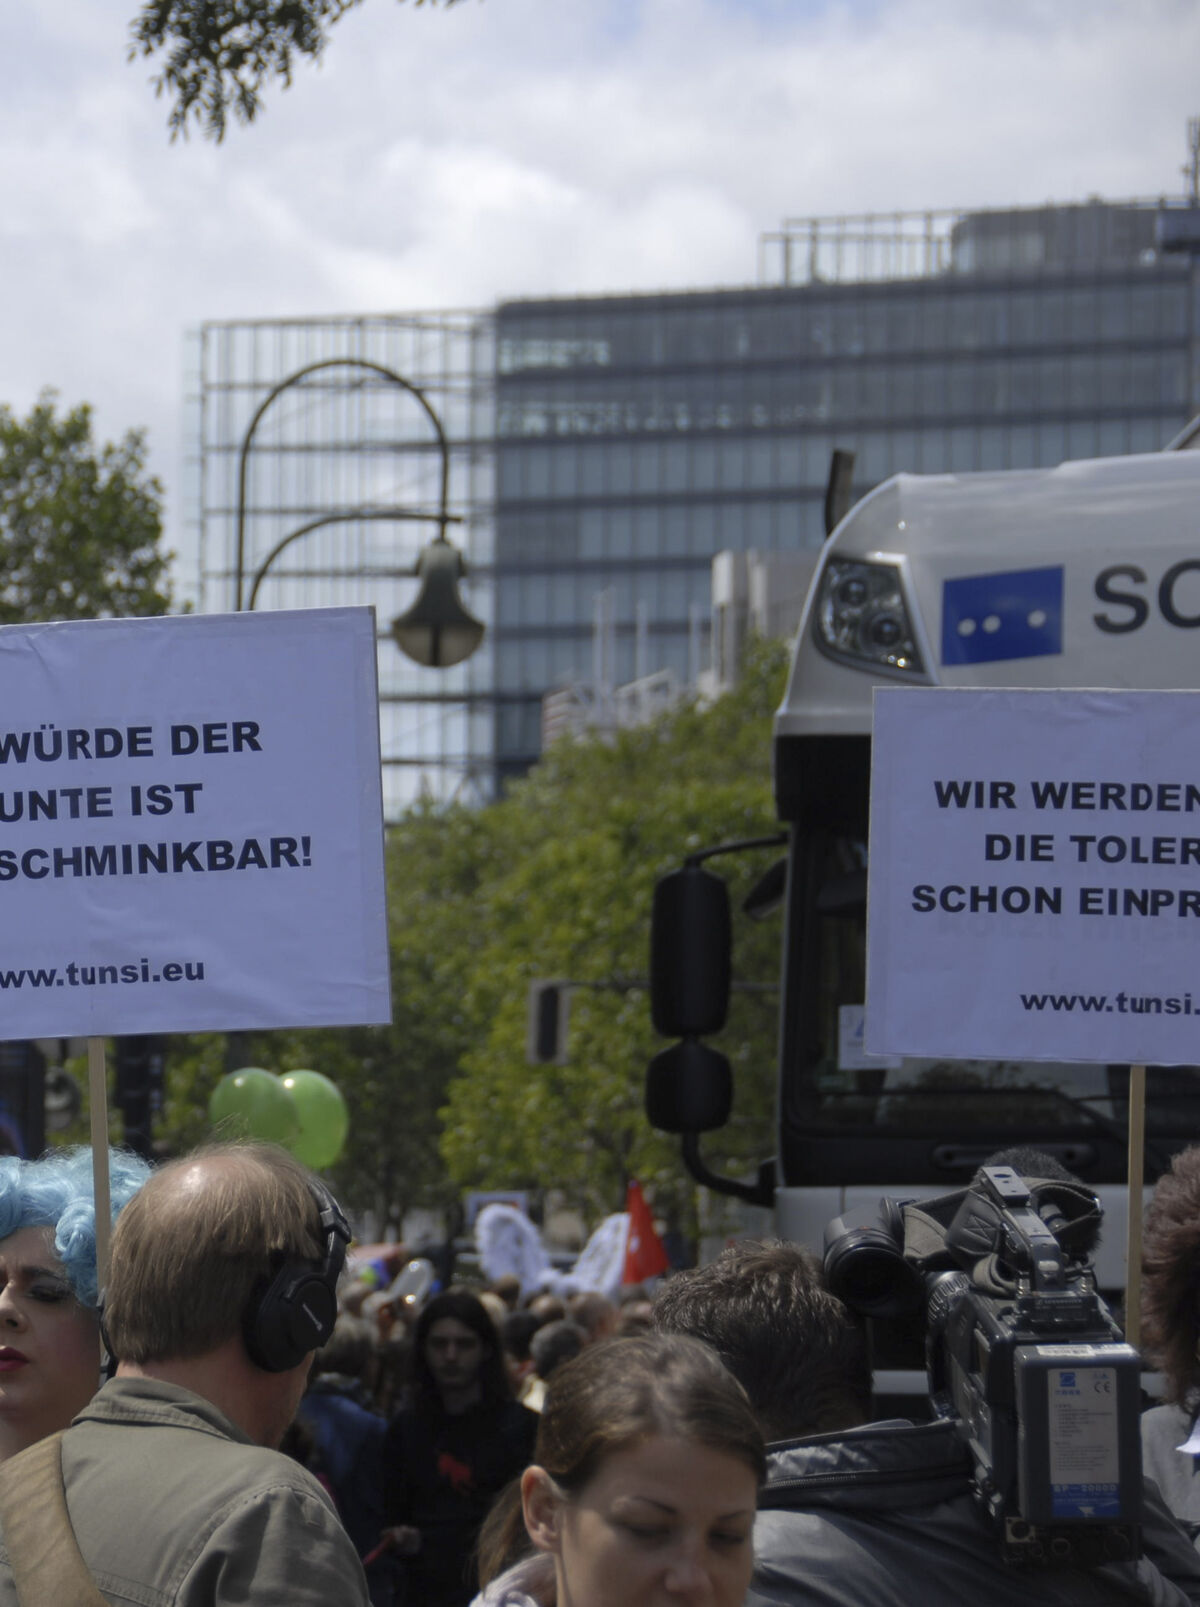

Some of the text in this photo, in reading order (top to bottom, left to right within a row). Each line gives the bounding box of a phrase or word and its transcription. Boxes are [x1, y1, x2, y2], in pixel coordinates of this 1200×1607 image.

[170, 721, 263, 756] DER
[130, 782, 203, 817] IST
[934, 781, 1017, 809] WIR
[984, 834, 1200, 866] DIE TOLER
[911, 884, 1200, 918] SCHON EINPR
